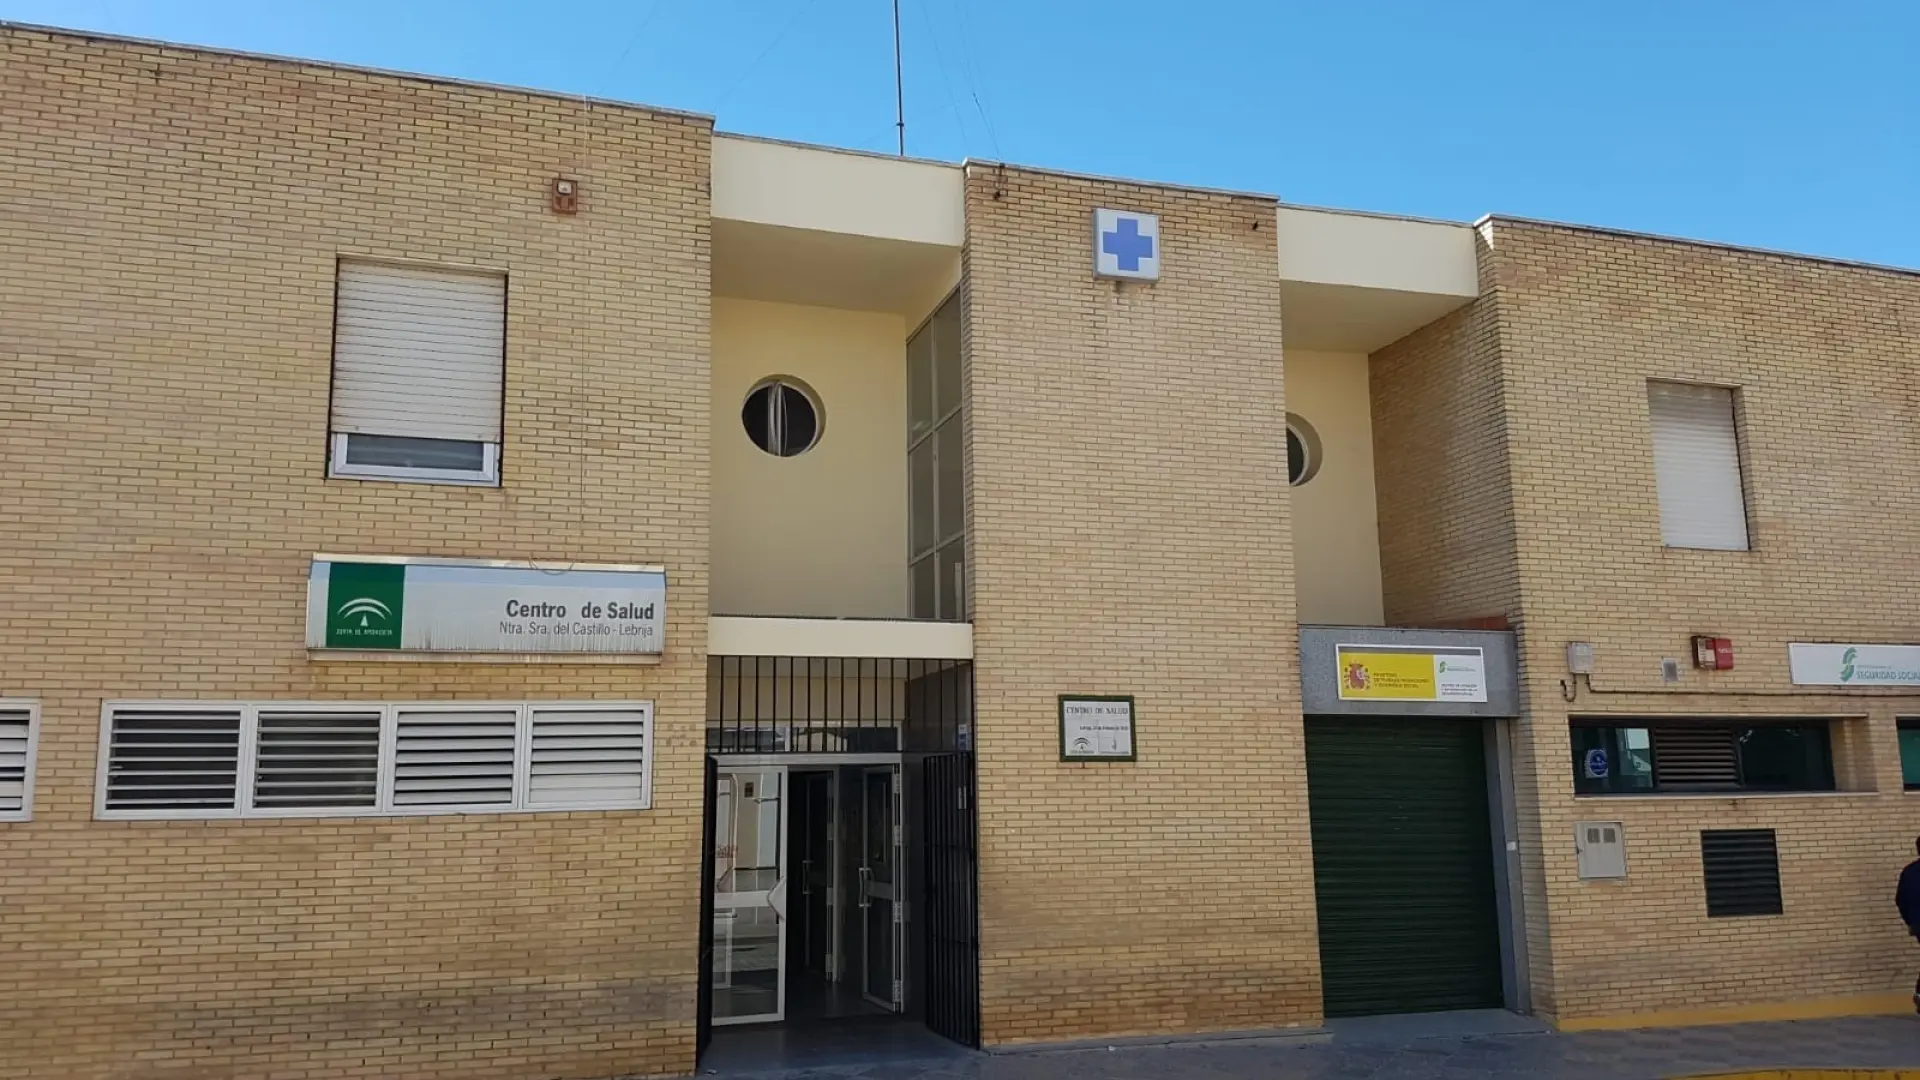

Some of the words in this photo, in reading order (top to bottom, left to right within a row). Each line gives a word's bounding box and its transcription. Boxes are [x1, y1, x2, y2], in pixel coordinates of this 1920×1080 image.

[506, 598, 567, 617] Centro
[581, 600, 602, 618] de
[607, 601, 655, 619] Salud
[499, 621, 526, 635] Ntra.
[528, 621, 551, 635] Sra.
[553, 622, 570, 636] del
[572, 622, 611, 636] Castillo
[619, 623, 653, 638] Lebrija
